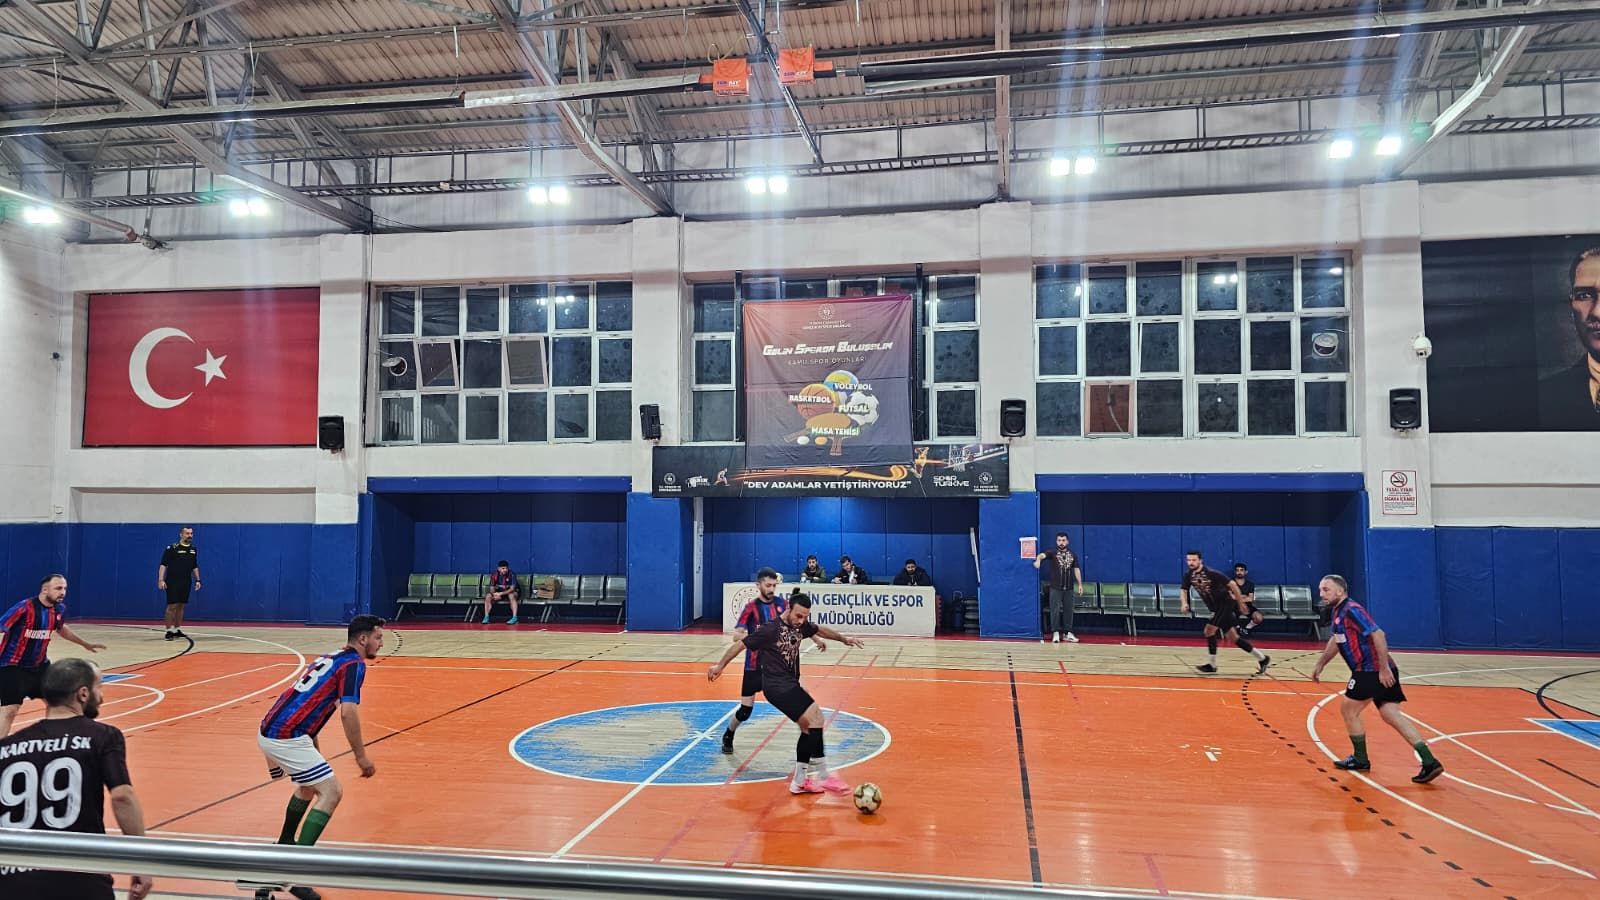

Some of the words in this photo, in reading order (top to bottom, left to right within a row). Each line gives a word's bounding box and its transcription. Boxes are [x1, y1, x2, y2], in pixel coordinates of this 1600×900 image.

[834, 383, 873, 391] VOLEYBOL
[789, 394, 832, 404] BASKETBOL
[838, 404, 869, 413] FUTSAL
[811, 427, 834, 436] MASA
[771, 481, 822, 489] ADAMLAR
[823, 591, 872, 609] GENÇLİK
[873, 594, 890, 607] VE
[892, 594, 924, 608] SPOR
[818, 610, 895, 626] MÜDÜRLÜĞÜ
[0, 733, 70, 760] KARTVELİ
[71, 735, 92, 750] SK
[0, 756, 83, 830] 99
